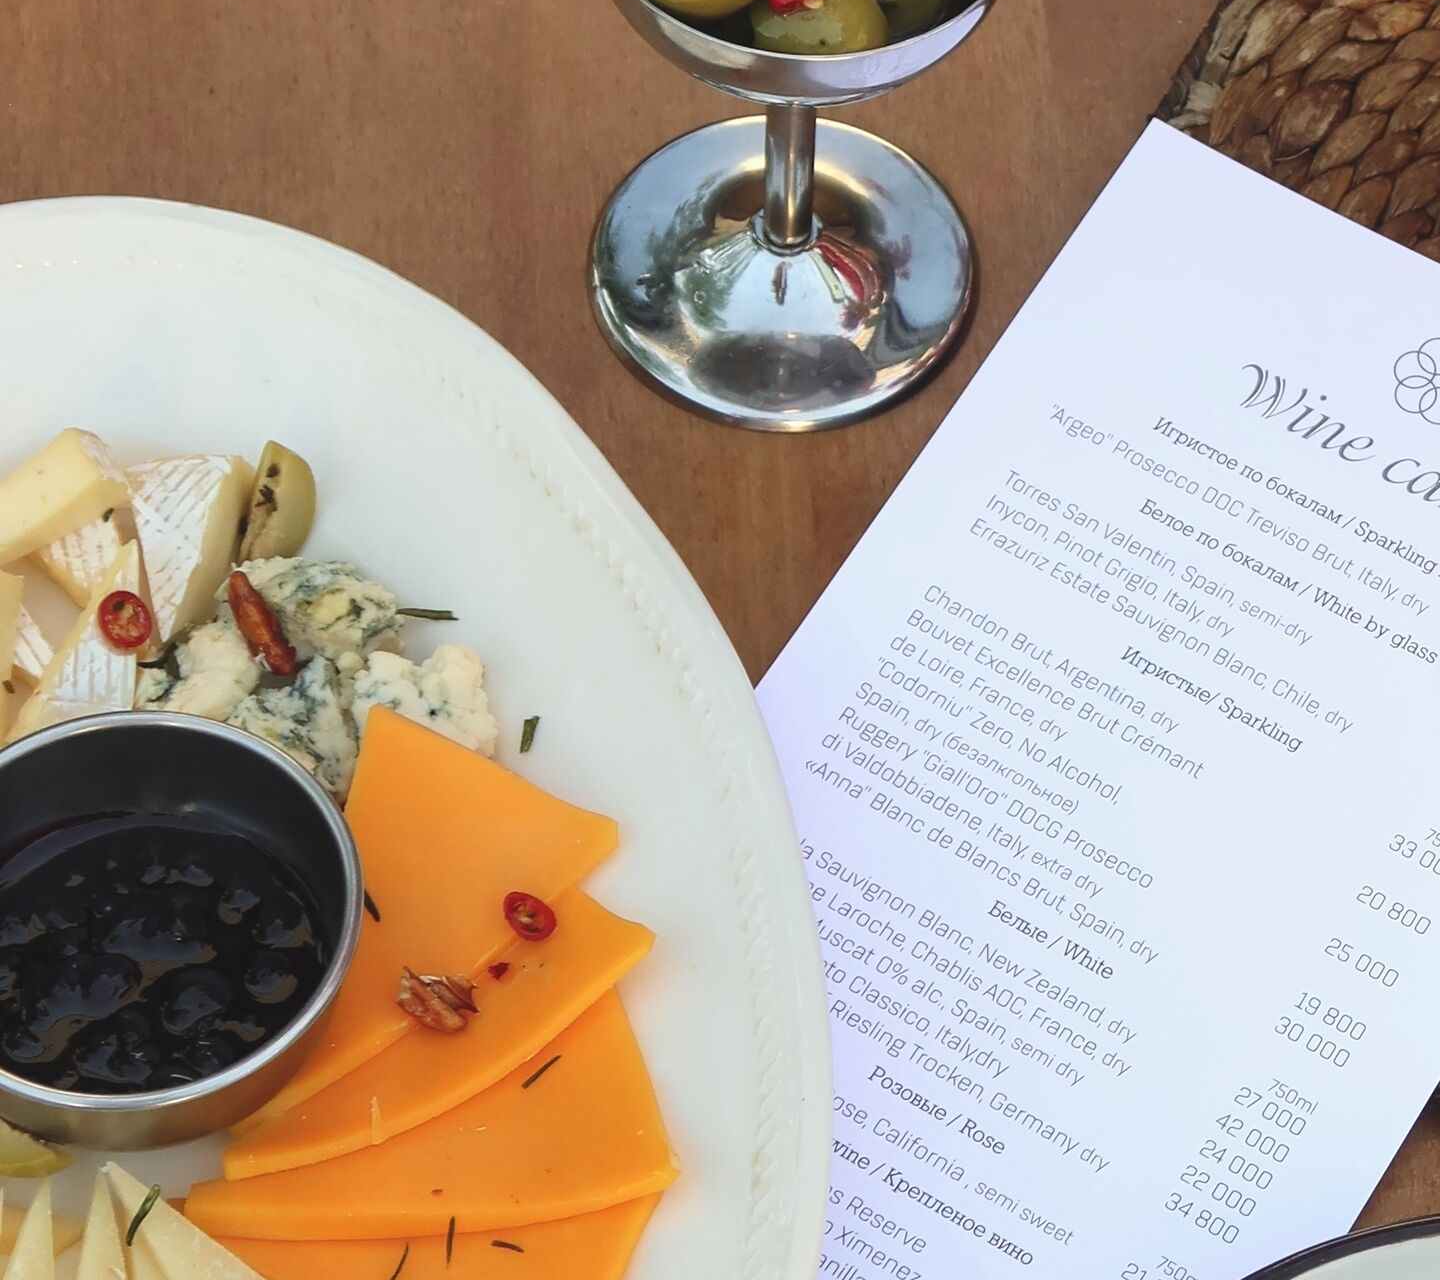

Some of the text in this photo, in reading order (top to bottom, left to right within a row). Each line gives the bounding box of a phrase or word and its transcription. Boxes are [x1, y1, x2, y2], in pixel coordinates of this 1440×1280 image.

[1239, 363, 1377, 463] Wine
[1112, 439, 1200, 496] Prosecco
[1201, 486, 1245, 518] DOC
[1246, 507, 1310, 552] Treviso
[1311, 543, 1355, 579] Brut,
[1356, 566, 1400, 602] Italy,
[1400, 593, 1430, 617] dry
[1152, 416, 1239, 471] Игристое
[1238, 464, 1264, 483] по
[1265, 476, 1344, 525] бокалам
[1353, 520, 1440, 575] Sparkling
[985, 494, 1235, 639] Inycon, Pinot Grigio, Italy, dry
[1004, 469, 1313, 647] Torres San Valentin, Spain, semi-dry
[1138, 497, 1439, 664] Белое по бокалам White by glass
[923, 585, 1180, 734] Chandon Brut, Argentina, dry
[969, 517, 1354, 734] Errazuriz Estate Sauvignon Blanc, Chile, dry
[855, 682, 910, 727] Spain,
[913, 718, 944, 742] dry
[889, 635, 1069, 742] de Loire, France, dry
[906, 608, 1204, 780] Bouvet Excellence Brut Crémant
[1217, 696, 1304, 753] Sparkling
[838, 706, 919, 762] Ruggery
[1005, 798, 1064, 839] DOCG
[1062, 829, 1154, 889] Prosecco
[969, 710, 1014, 750] Zero,
[1017, 737, 1047, 763] No
[1046, 755, 1123, 806] Alcohol,
[821, 733, 1104, 899] di Valdobbiadene, Italy, extra dry
[1388, 833, 1418, 859] 33
[869, 792, 926, 834] Blanc
[926, 826, 954, 849] de
[954, 839, 1022, 888] Blancs
[1022, 877, 1067, 916] Brut,
[1069, 902, 1125, 949] Spain,
[1129, 939, 1160, 965] dry
[1355, 885, 1432, 935] 20 800
[815, 851, 916, 919] Sauvignon
[917, 908, 974, 956] Blanc,
[977, 942, 1026, 978] New
[1023, 968, 1107, 1029] Zealand,
[1107, 1019, 1137, 1045] dry
[827, 892, 907, 953] Laroche,
[910, 940, 983, 992] Chablis
[981, 983, 1028, 1021] AOC,
[1028, 1006, 1098, 1061] France,
[1101, 1052, 1132, 1078] dry
[987, 899, 1114, 980] Белые White
[1324, 937, 1400, 988] 25 000
[1274, 1015, 1351, 1068] 30 000
[1293, 992, 1367, 1041] 19 800
[829, 999, 1111, 1174] Riesling Trocken, Germany dry
[866, 1064, 1005, 1155] Розовые Rose
[1233, 1086, 1307, 1136] 27 000
[1267, 1078, 1319, 1116] 750ml
[872, 1117, 1074, 1247] California semi sweet
[1198, 1139, 1274, 1190] 24 000
[1215, 1113, 1291, 1163] 42 000
[881, 1166, 987, 1238] Крепленое
[986, 1232, 1034, 1266] вино
[1164, 1192, 1240, 1245] 34 800
[1179, 1164, 1257, 1217] 22 000
